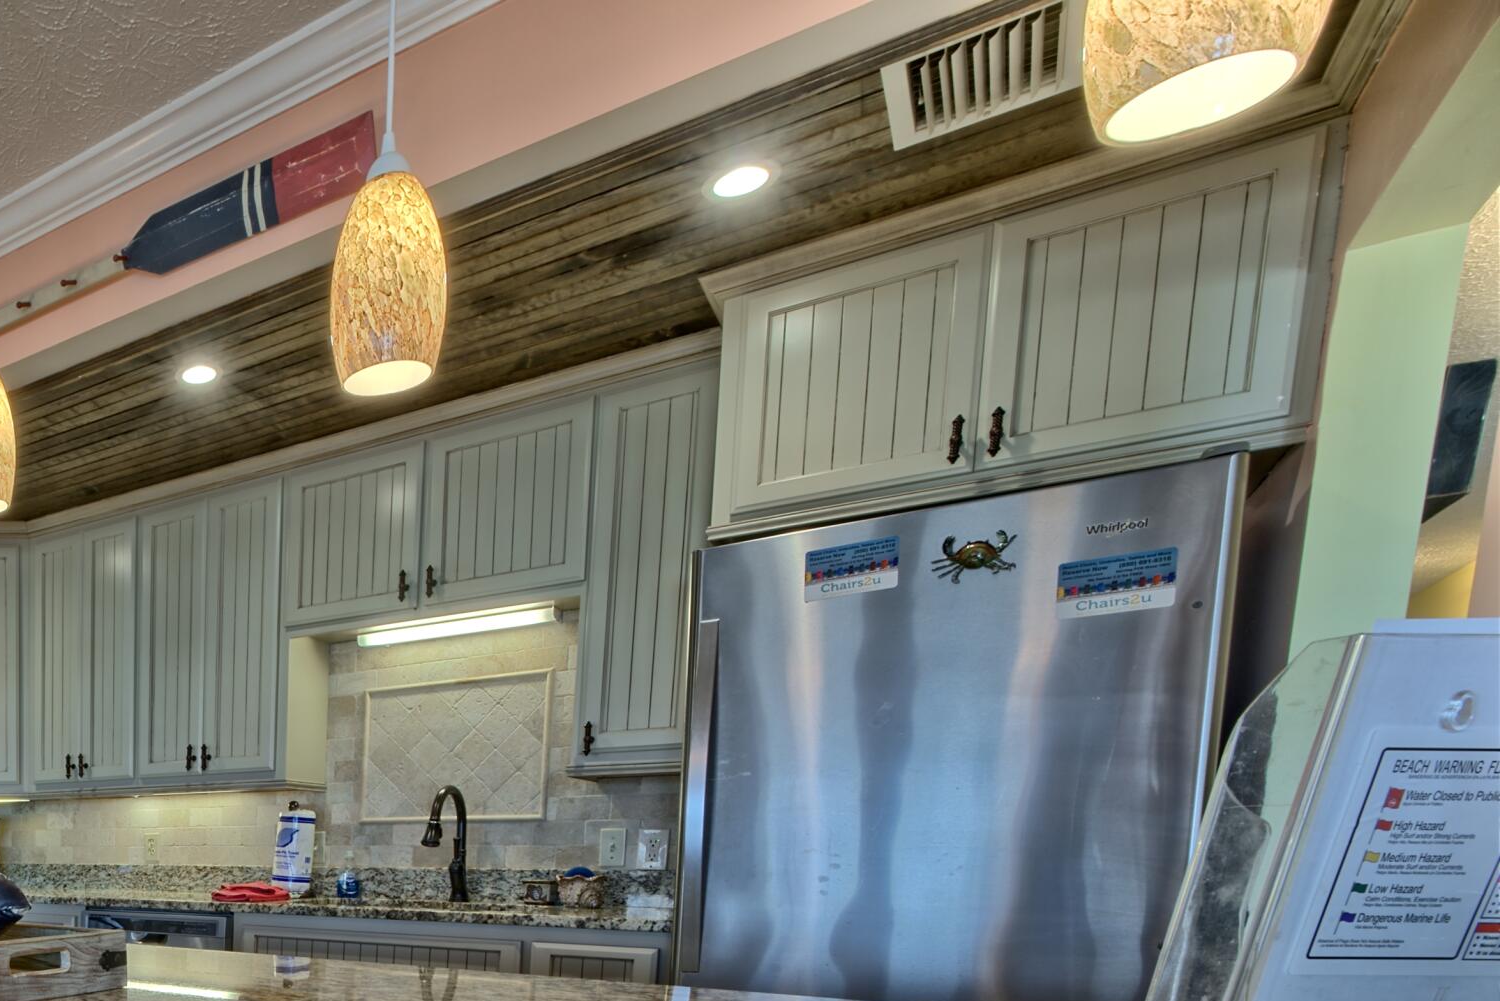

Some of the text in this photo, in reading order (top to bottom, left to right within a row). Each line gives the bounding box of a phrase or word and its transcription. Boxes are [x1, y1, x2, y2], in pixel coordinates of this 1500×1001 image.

[1086, 518, 1149, 535] Whirlpool
[820, 576, 881, 593] Chairs2u
[1075, 593, 1152, 611] Chairs2u
[1392, 760, 1431, 774] BEACH
[1433, 760, 1485, 774] WARNING
[1405, 790, 1432, 802] Water
[1432, 790, 1463, 802] Closed
[1464, 791, 1474, 802] to
[1392, 821, 1446, 833] High Hazard
[1380, 852, 1452, 863] Medium Hazard
[1368, 883, 1424, 894] Low Hazard
[1356, 913, 1451, 925] Dangerous Marine Life
